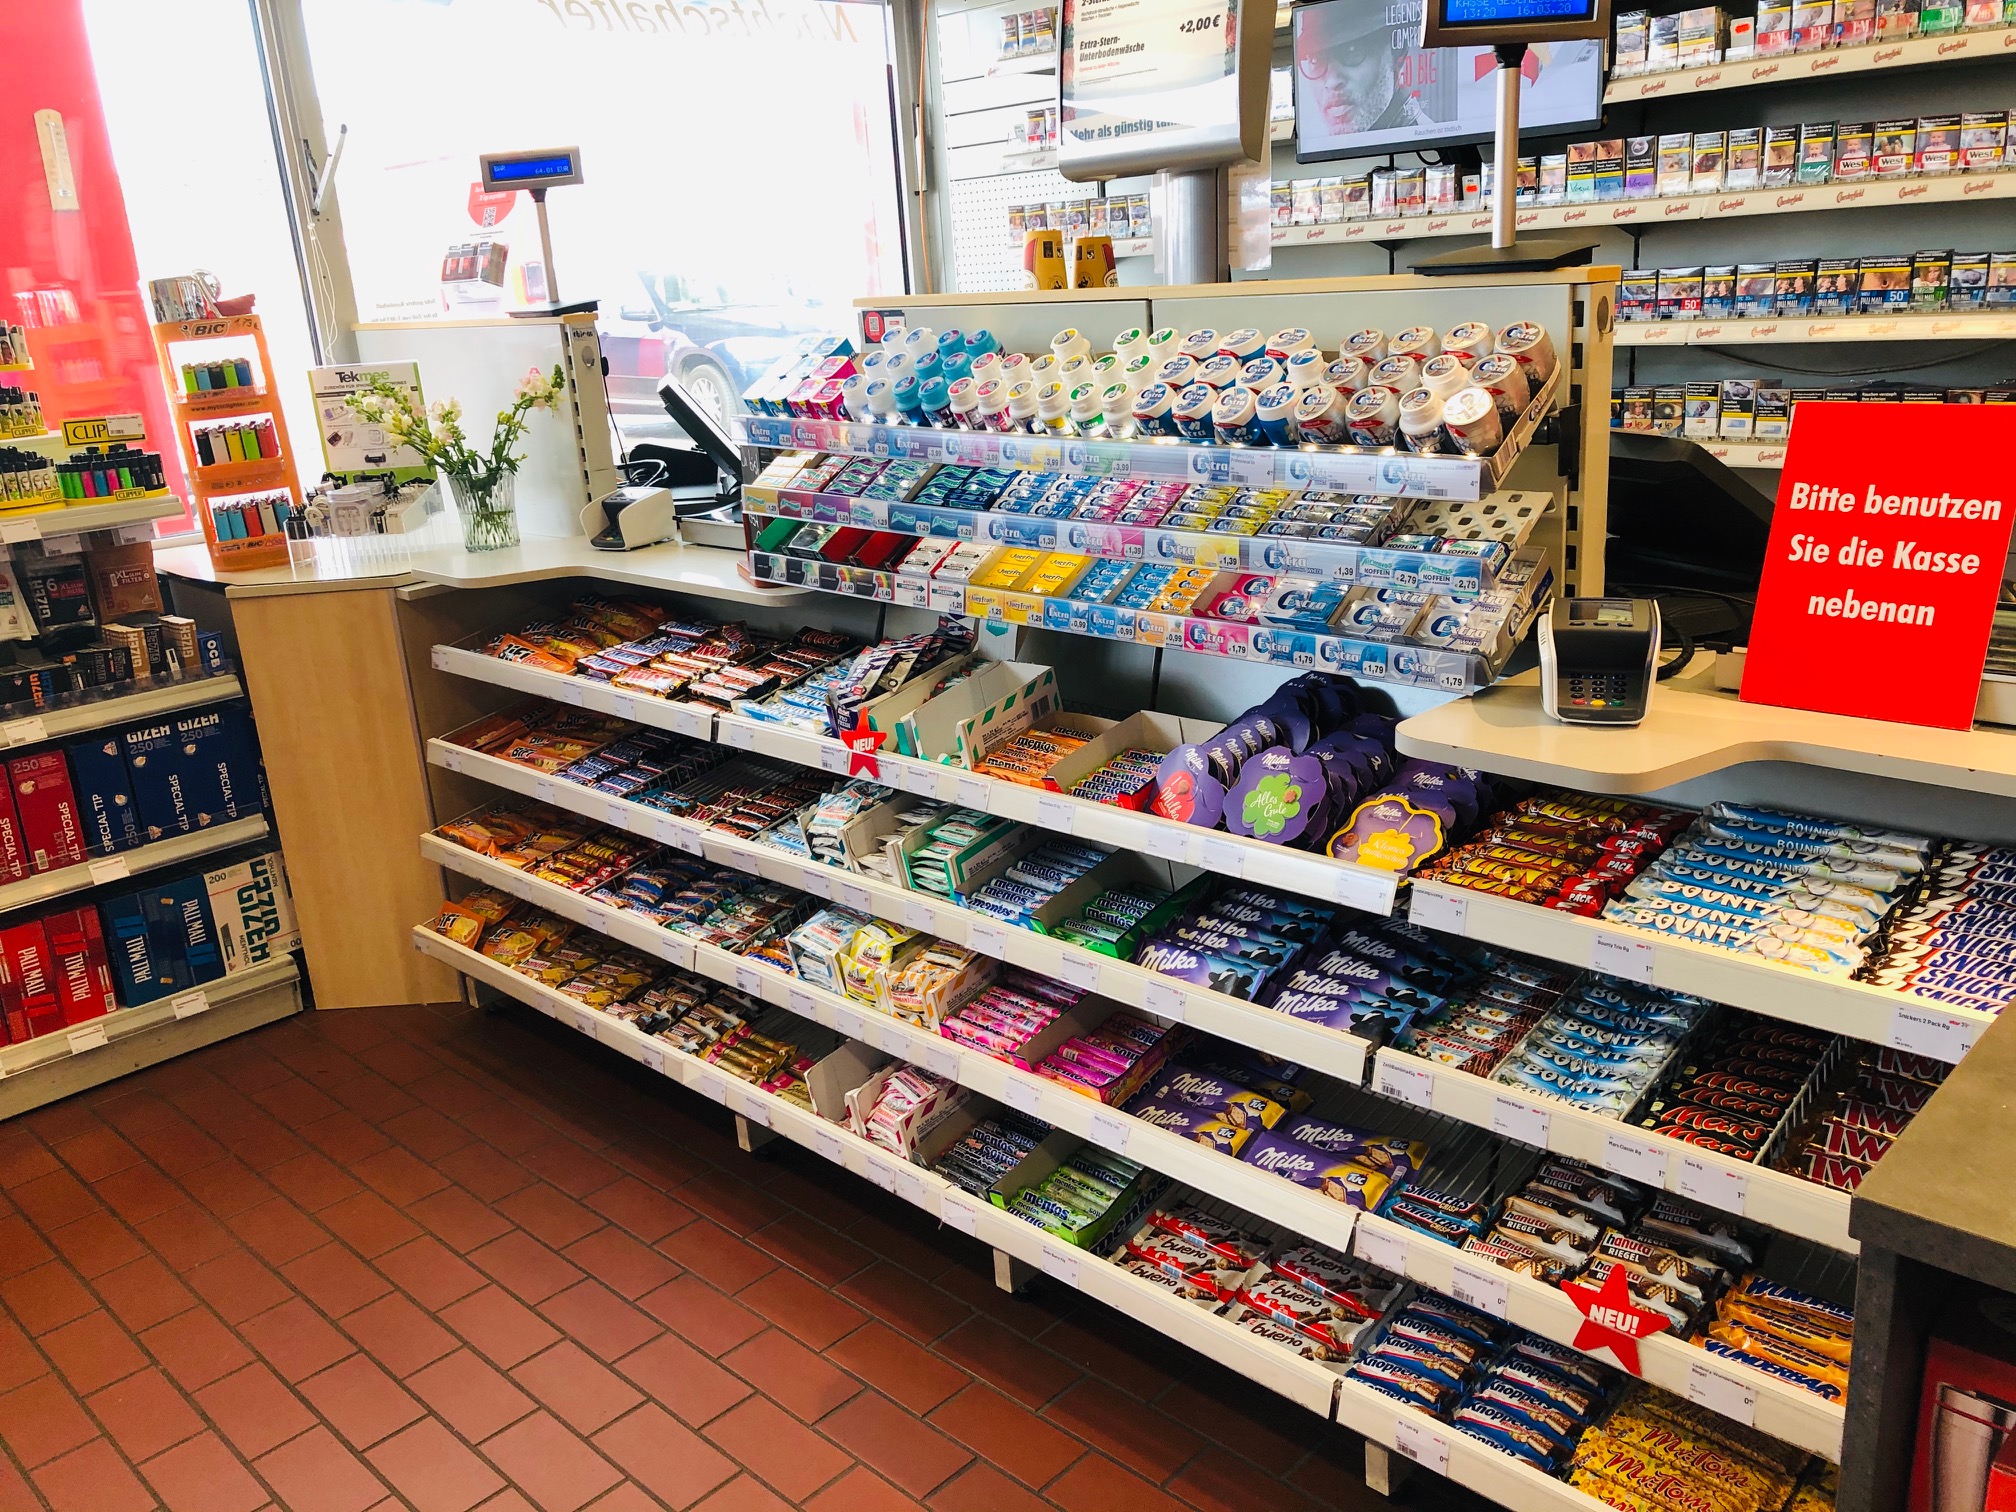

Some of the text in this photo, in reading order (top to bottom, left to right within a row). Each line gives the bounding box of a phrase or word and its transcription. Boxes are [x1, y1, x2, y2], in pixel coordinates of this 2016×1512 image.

[1386, 2, 1422, 26] LEGENDS
[1463, 3, 1572, 18] 13:20 16.03.20
[1180, 14, 1221, 34] +2,00 €
[1079, 42, 1145, 62] Unterbodenwäsche
[1080, 35, 1121, 50] Extra-Stern-
[1418, 52, 1438, 84] BIG
[1098, 125, 1112, 138] als
[1114, 119, 1154, 138] günstig
[1414, 124, 1462, 136] Rauchen ist tödlich
[1881, 157, 1904, 166] West
[1924, 153, 1948, 162] West
[1970, 150, 1994, 159] West
[1685, 300, 1697, 310] 50
[1890, 290, 1903, 301] 50
[194, 322, 228, 338] BIC
[335, 369, 390, 383] Tekmee
[190, 400, 261, 412] www.mybiclighter.com
[73, 424, 107, 440] CLIP
[1193, 451, 1230, 474] Extra
[118, 490, 144, 498] CLIPPER
[1790, 482, 2002, 520] Bitte benutzen
[1158, 533, 1197, 558] Extra
[1788, 534, 1980, 574] Sie die Kasse
[115, 570, 130, 580] XL
[122, 576, 142, 584] FILTER
[1364, 568, 1390, 576] KOFFEIN
[1423, 574, 1451, 582] KOFFEIN
[1277, 590, 1326, 614] Extra
[1808, 588, 1935, 626] nebenan
[1353, 604, 1407, 630] Extra
[1190, 624, 1224, 645] Extra
[1431, 615, 1490, 641] Extra
[128, 633, 142, 668] GIZEH
[182, 624, 194, 658] GIZEH
[1458, 639, 1481, 648] WHITE
[206, 640, 221, 668] OCB
[1394, 650, 1437, 677] Extra
[30, 672, 45, 707] GIZEH
[178, 713, 219, 732] GIZEH
[127, 724, 170, 744] GIZEH
[852, 736, 875, 751] NEU!
[1017, 736, 1058, 753] mentos
[130, 742, 153, 755] 250
[1263, 752, 1291, 766] Milka
[12, 759, 39, 774] 250
[987, 757, 1028, 773] mentos
[217, 762, 236, 818] SPECIAL TIP
[1251, 792, 1279, 808] Alles
[92, 794, 104, 812] TIP
[168, 774, 190, 831] SPECIAL TIP
[1264, 802, 1288, 818] Gute
[59, 802, 81, 860] SPECIAL TIP
[97, 811, 114, 852] SPECIAL
[0, 818, 22, 878] SPECIAL TIP
[1373, 839, 1406, 856] Kleines
[1615, 838, 1638, 850] PACK
[1363, 846, 1408, 866] Dankeschön
[208, 872, 226, 884] 200
[1468, 856, 1540, 884] LION
[994, 878, 1038, 898] mentos
[1569, 892, 1593, 904] PACK
[1660, 880, 1783, 916] BOUNTY
[182, 898, 206, 946] PALL MALL
[237, 884, 270, 966] GIZEH
[1086, 908, 1134, 930] mentos
[1634, 908, 1758, 946] BOUNTY
[1597, 940, 1613, 950] Bounty
[1931, 932, 2016, 962] SNICK
[126, 935, 152, 985] PALL MALL
[1141, 945, 1198, 971] Milka
[1318, 951, 1380, 980] Milka
[18, 946, 46, 997] PALL MALL
[65, 952, 91, 1002] PALL MALL
[1272, 990, 1340, 1015] Milka
[1564, 1018, 1648, 1046] BOUNTY
[1898, 1012, 1922, 1024] Snickers
[1928, 1020, 1942, 1028] Pack
[1942, 1023, 1950, 1031] Rg
[1172, 1072, 1223, 1096] Milka
[1694, 1070, 1790, 1100] Mars
[1661, 1105, 1766, 1140] Mars
[1608, 1140, 1618, 1148] Mars
[1618, 1143, 1634, 1154] Classic
[1254, 1146, 1316, 1172] Milka
[1348, 1173, 1367, 1185] TUC
[1023, 1190, 1071, 1220] mentos
[1439, 1202, 1458, 1213] CRISP
[1505, 1210, 1548, 1230] hanuta
[1506, 1221, 1536, 1234] RIEGEL
[1606, 1232, 1650, 1255] hanuta
[1608, 1247, 1640, 1262] RIEGEL
[1131, 1264, 1178, 1288] bueno
[1272, 1282, 1323, 1308] bueno
[1589, 1304, 1640, 1334] NEU!
[1251, 1320, 1303, 1347] bueno
[1504, 1358, 1570, 1388] Knoppers
[1705, 1340, 1842, 1400] WUNDERBAR
[1471, 1402, 1536, 1432] Knoppers
